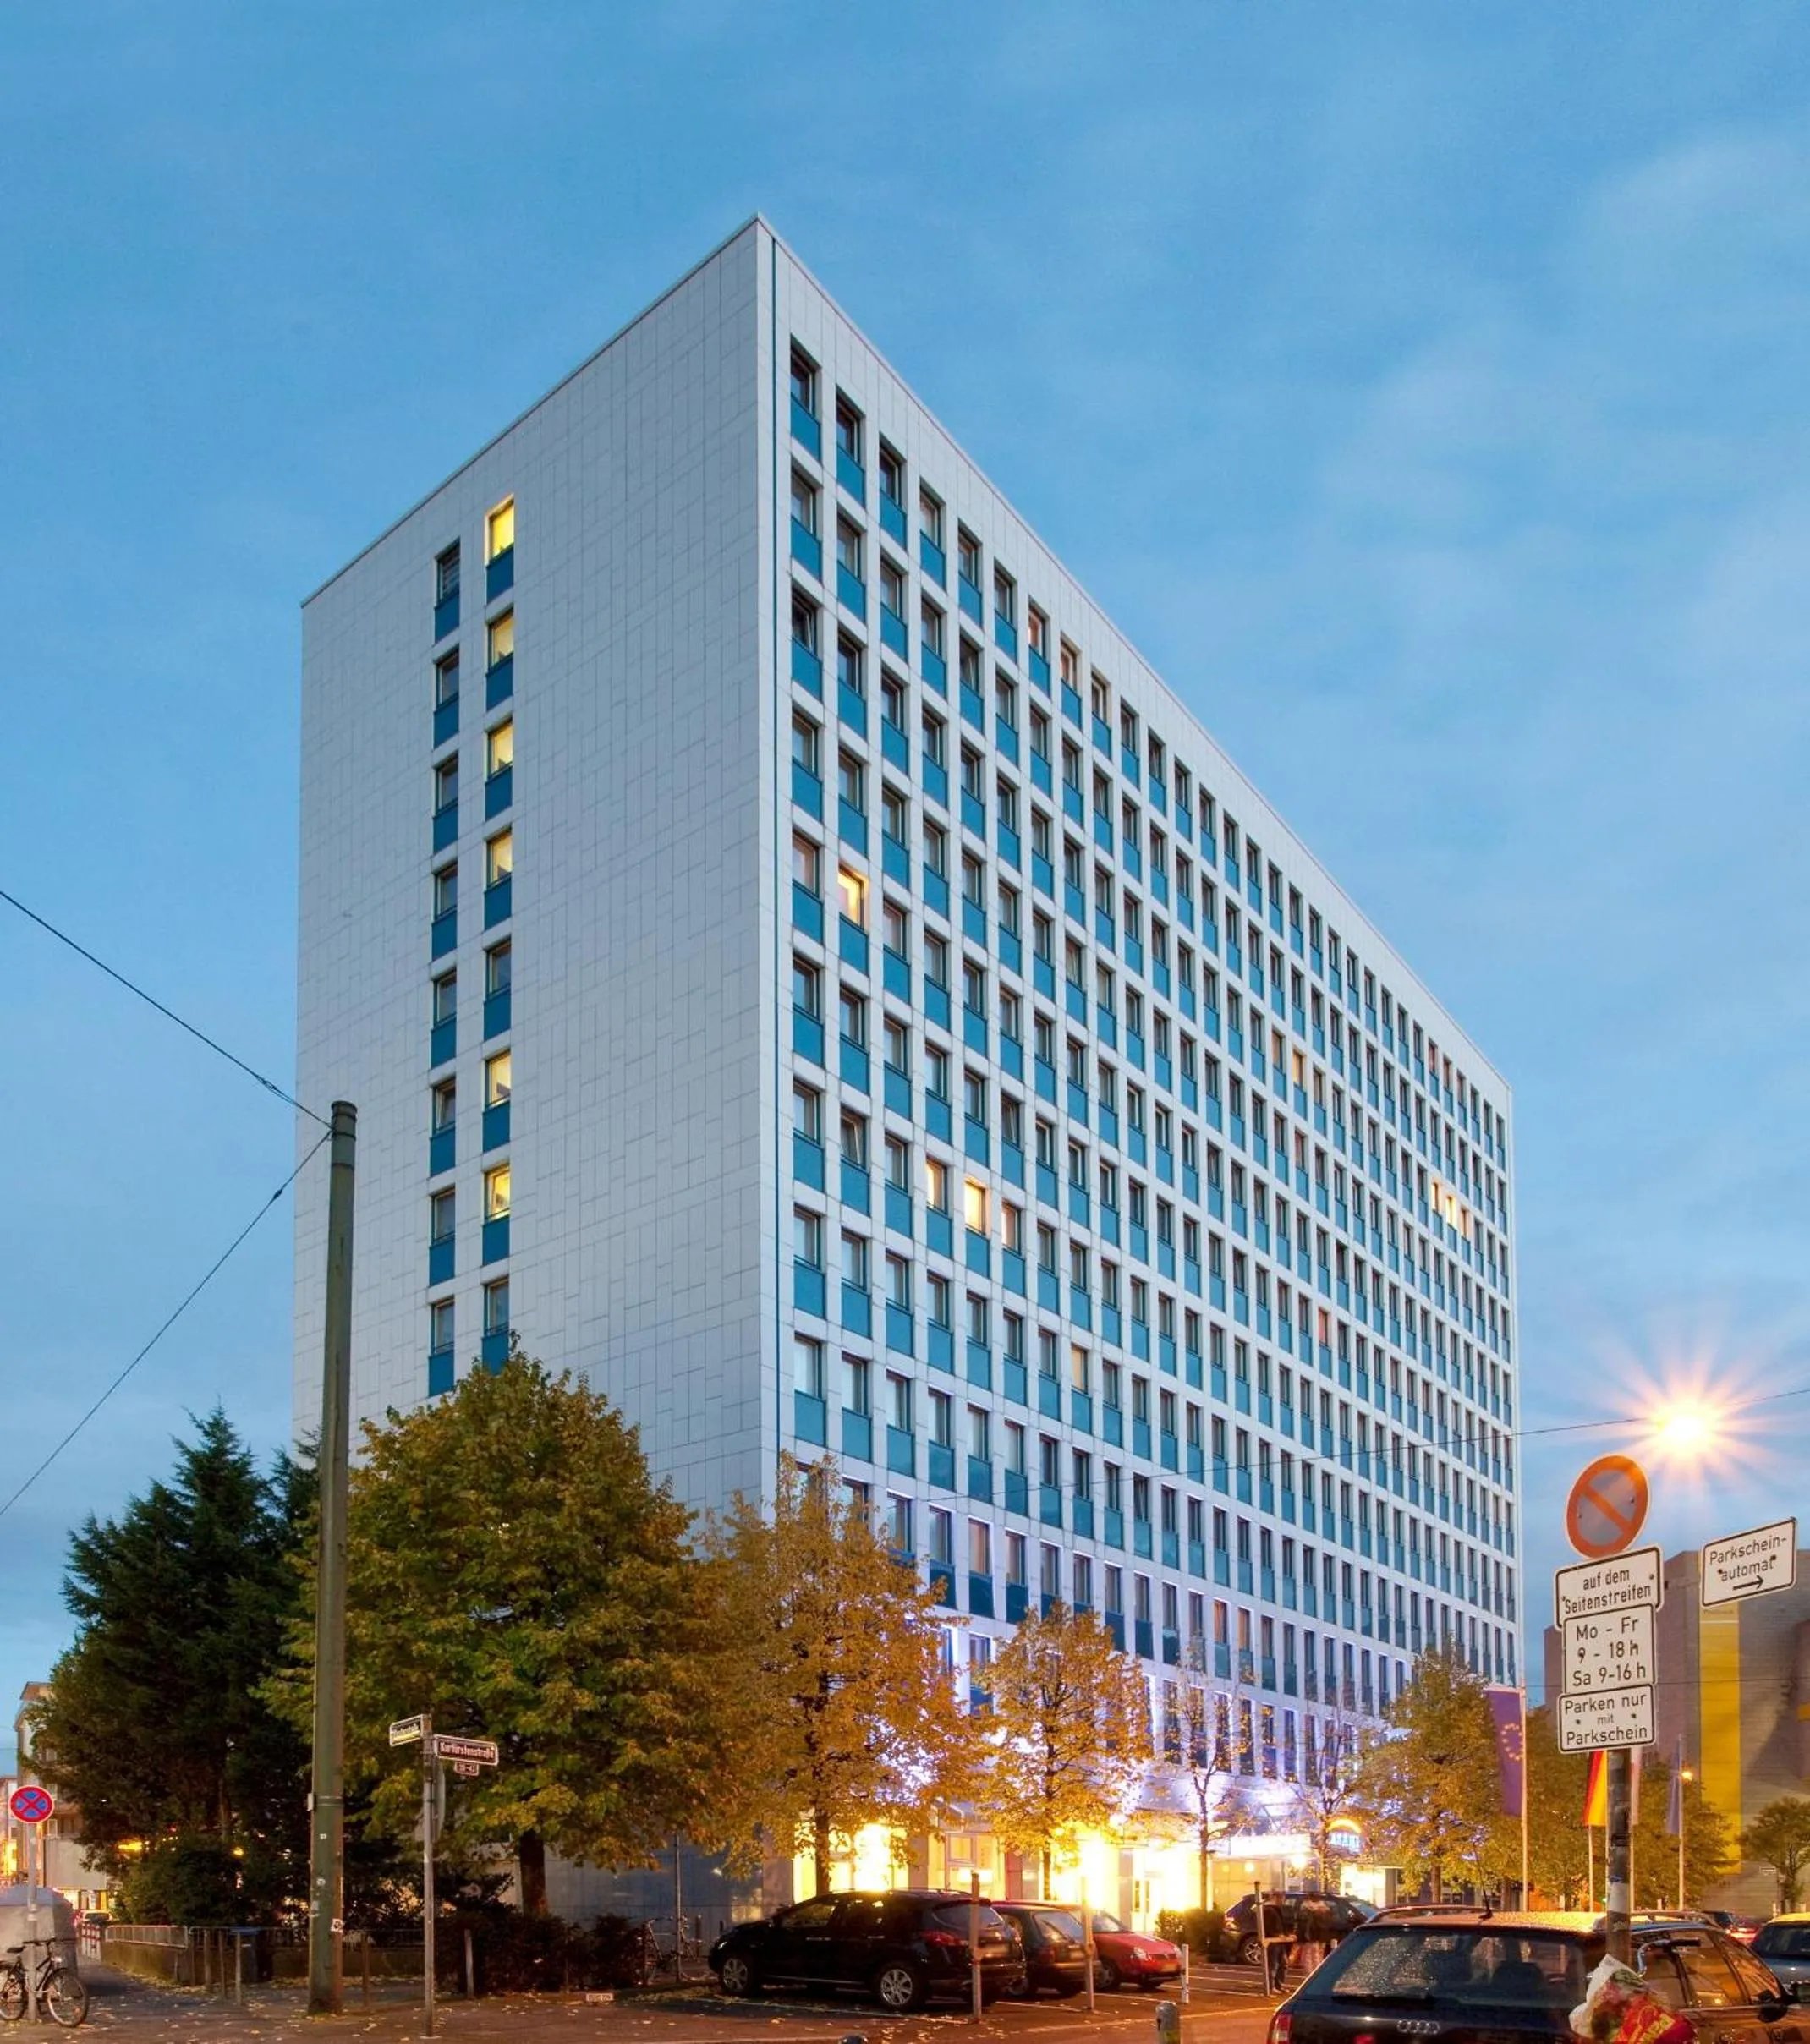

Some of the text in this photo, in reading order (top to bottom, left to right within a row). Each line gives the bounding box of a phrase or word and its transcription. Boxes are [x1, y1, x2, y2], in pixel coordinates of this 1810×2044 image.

[1709, 1535, 1786, 1565] Parkschein-
[1583, 1569, 1630, 1590] auf dem
[1720, 1556, 1774, 1581] automat
[1565, 1585, 1651, 1614] Seitenstreifen
[1576, 1624, 1599, 1641] Mo
[1621, 1616, 1639, 1634] Fr
[1577, 1647, 1586, 1663] 9
[1609, 1641, 1626, 1658] 18
[1629, 1639, 1639, 1656] h
[1572, 1662, 1646, 1686] Sa 9-16 h
[1565, 1694, 1647, 1714] Parken nur
[1597, 1714, 1614, 1725] mit
[1566, 1725, 1648, 1746] Parkschein
